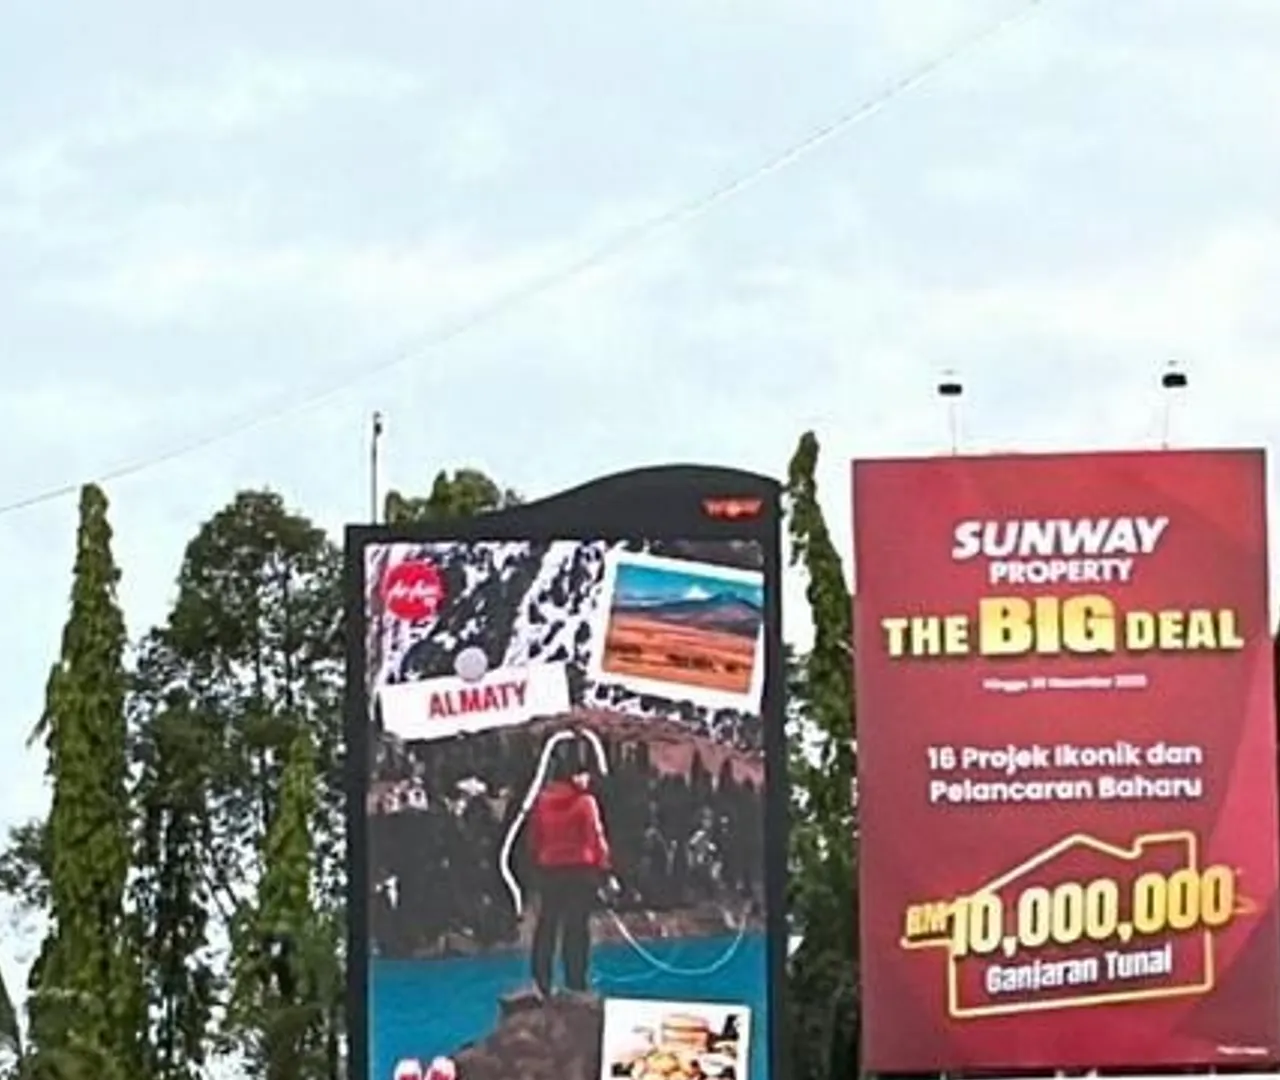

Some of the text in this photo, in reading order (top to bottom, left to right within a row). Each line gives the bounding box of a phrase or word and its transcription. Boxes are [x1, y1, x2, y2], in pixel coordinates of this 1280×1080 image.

[952, 517, 1169, 559] SUNWAY
[988, 558, 1133, 584] PROPERTY
[881, 594, 1245, 656] THE BIG DEAL
[428, 680, 527, 719] ALMATY
[961, 744, 1050, 775] Projek
[1054, 741, 1141, 767] Ikonik
[1146, 742, 1202, 765] dan
[930, 775, 1202, 802] Pelancaran Baharu
[986, 942, 1173, 994] Ganjaran Tunai
